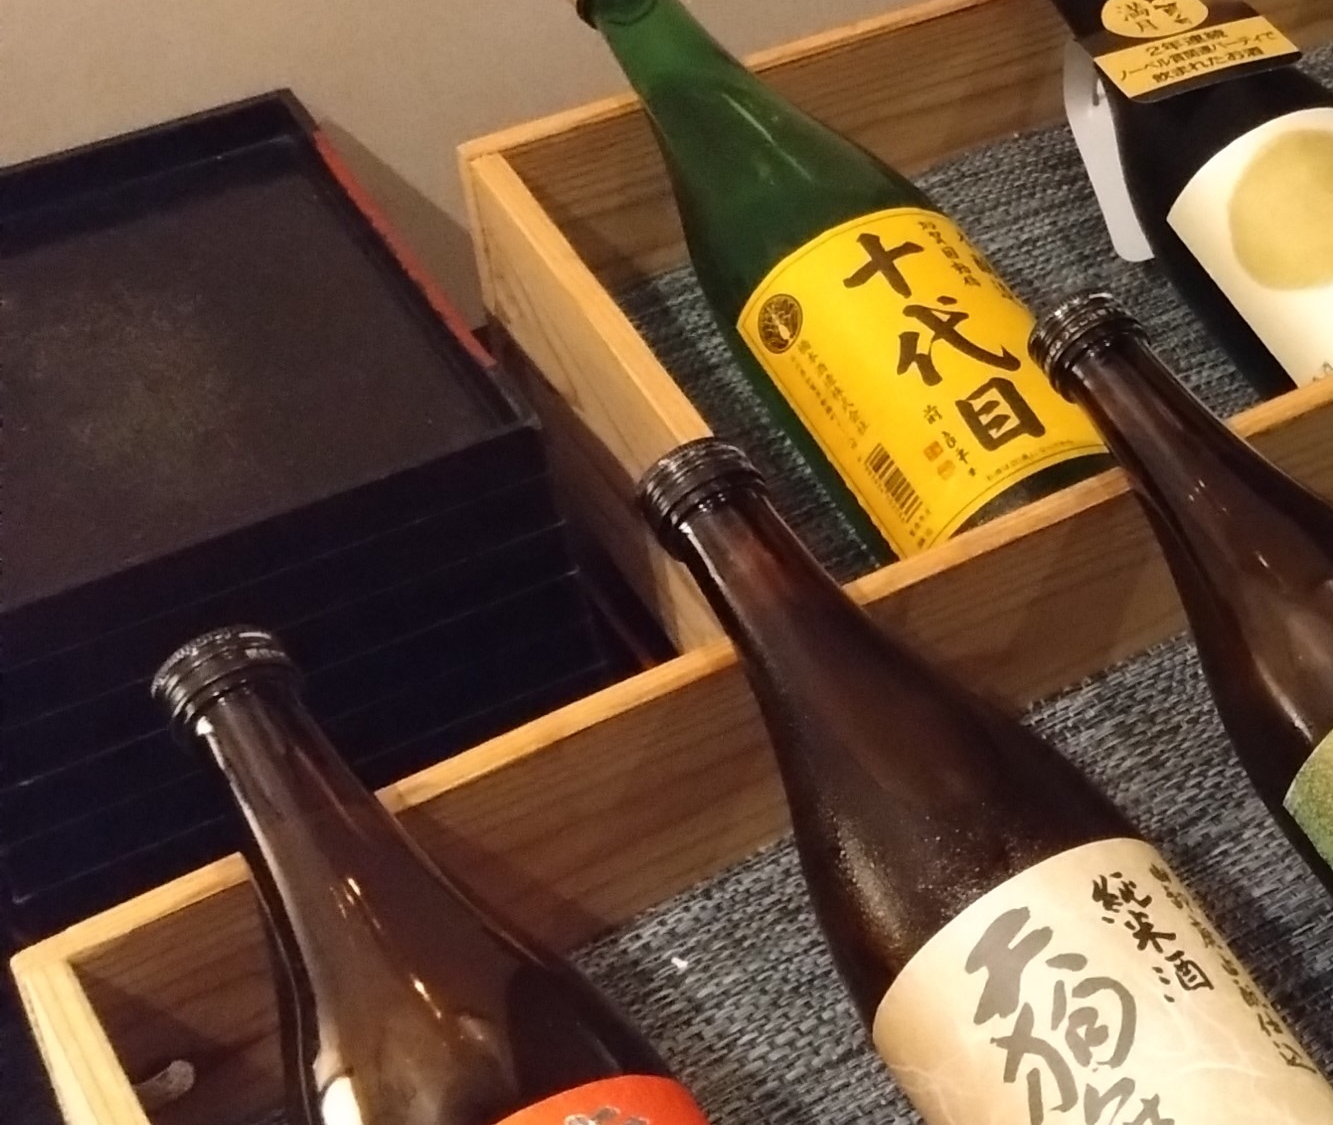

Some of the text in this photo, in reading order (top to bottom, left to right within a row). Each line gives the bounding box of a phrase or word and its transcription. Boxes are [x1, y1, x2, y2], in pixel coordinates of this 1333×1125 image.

[1145, 28, 1228, 57] 2年連続
[1151, 45, 1264, 84] 飲まれたお酒
[842, 232, 1047, 453] 十代目
[1091, 871, 1215, 1004] 純米酒
